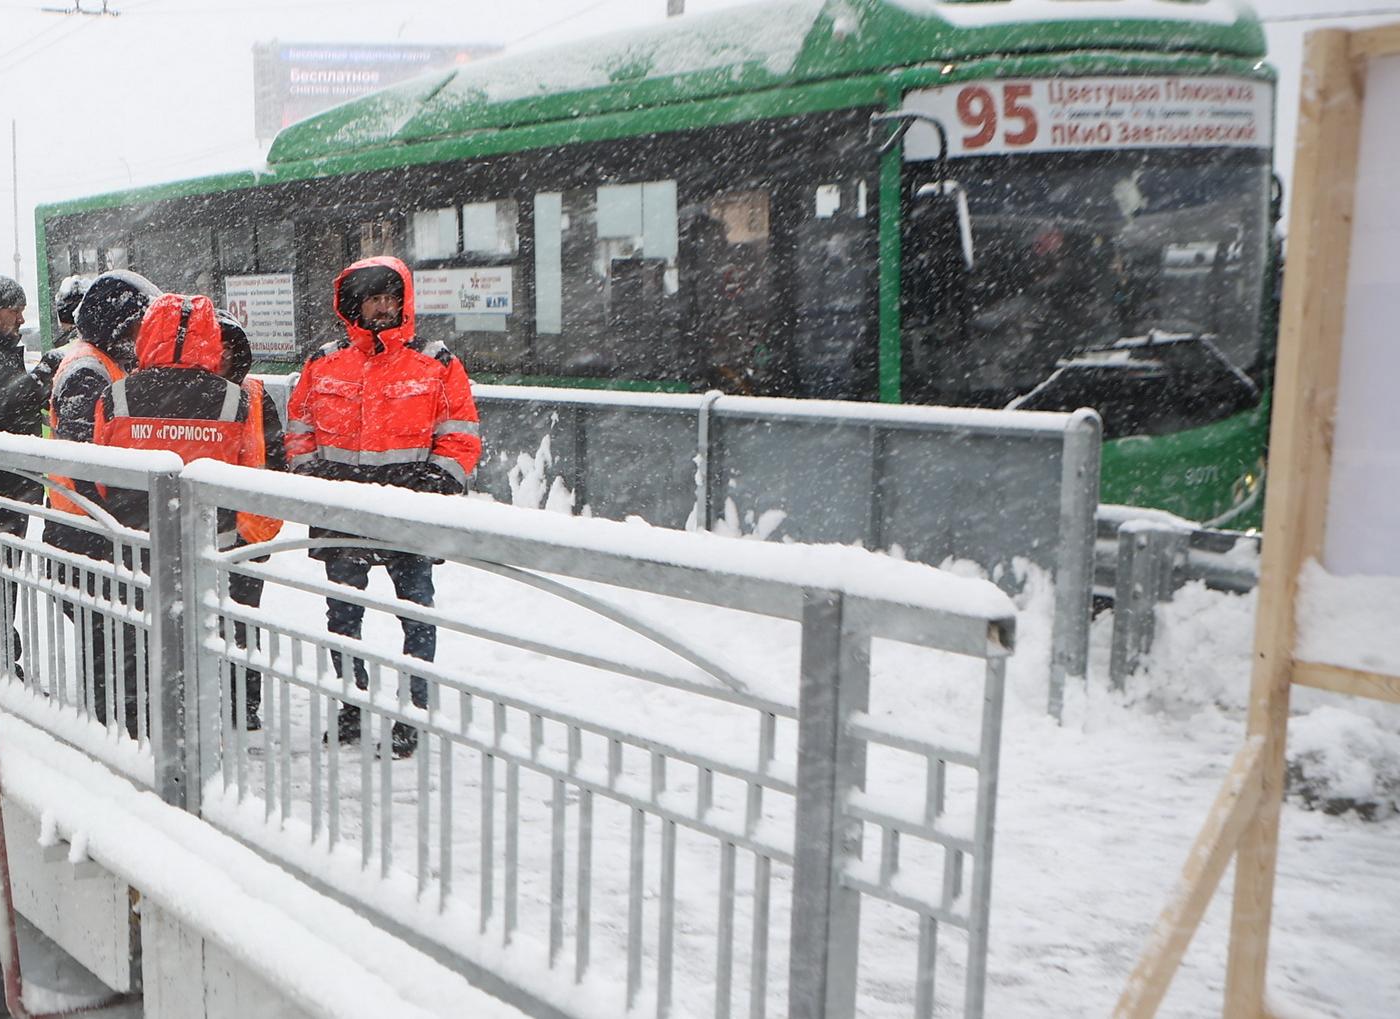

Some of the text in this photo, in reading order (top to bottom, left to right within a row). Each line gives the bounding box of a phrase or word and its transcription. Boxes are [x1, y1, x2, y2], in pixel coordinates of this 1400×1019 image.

[290, 68, 379, 82] Бесплатное
[1048, 78, 1160, 109] Цветущая
[956, 83, 1039, 149] 95
[1050, 122, 1112, 146] ПКиО
[131, 424, 223, 442] МКУ «ГОРМОСТ»
